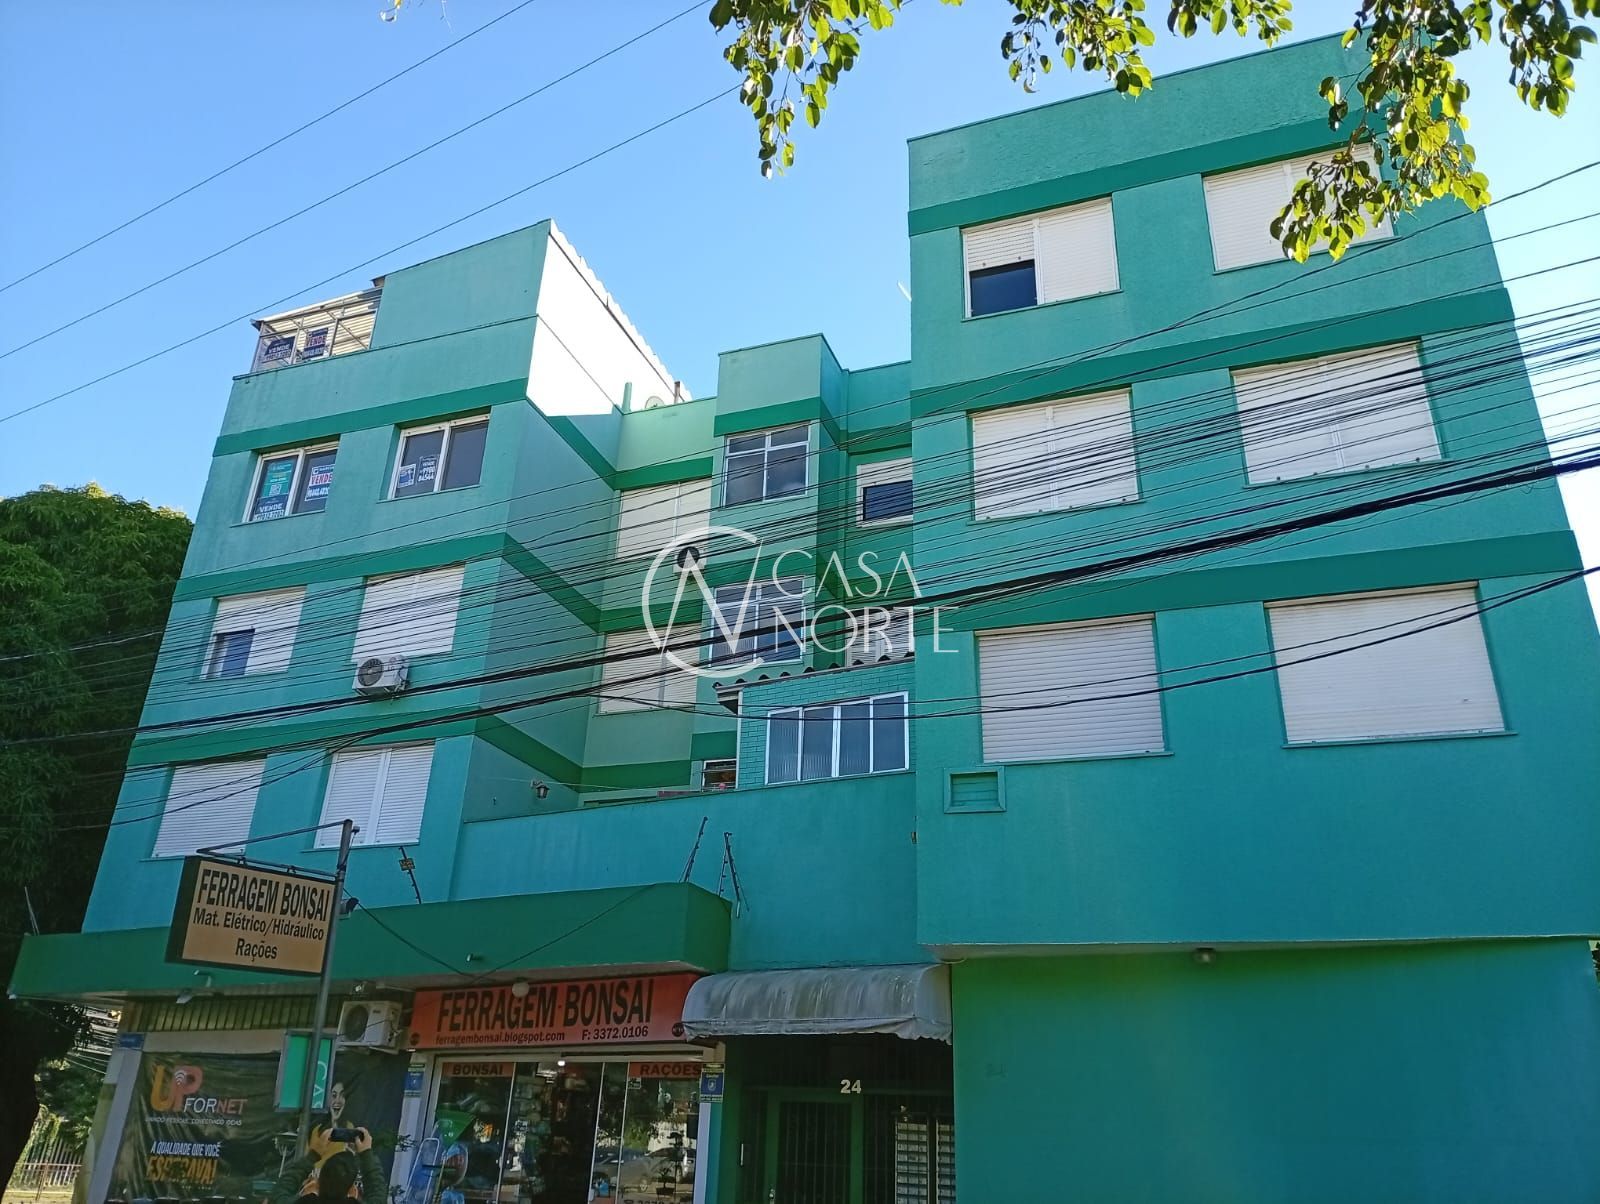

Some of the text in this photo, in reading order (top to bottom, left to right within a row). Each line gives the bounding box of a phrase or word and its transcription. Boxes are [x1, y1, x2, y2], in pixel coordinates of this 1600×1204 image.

[259, 503, 284, 513] VENDE
[197, 869, 331, 922] FERRAGEM BONSAI
[193, 907, 325, 941] Mat. Elétrico/Hidráulico
[235, 937, 278, 962] Rações
[437, 979, 654, 1032] FERRAGEM BONSAI
[435, 1026, 649, 1047] ferragembonsai.blogspot.com F: 3372.0106
[452, 1064, 504, 1075] BONSAI
[151, 1064, 204, 1112] UP
[840, 1079, 862, 1094] 24
[183, 1097, 249, 1116] FORNET
[150, 1140, 157, 1154] A
[157, 1141, 192, 1156] QUALIDADE
[191, 1143, 205, 1156] QUE
